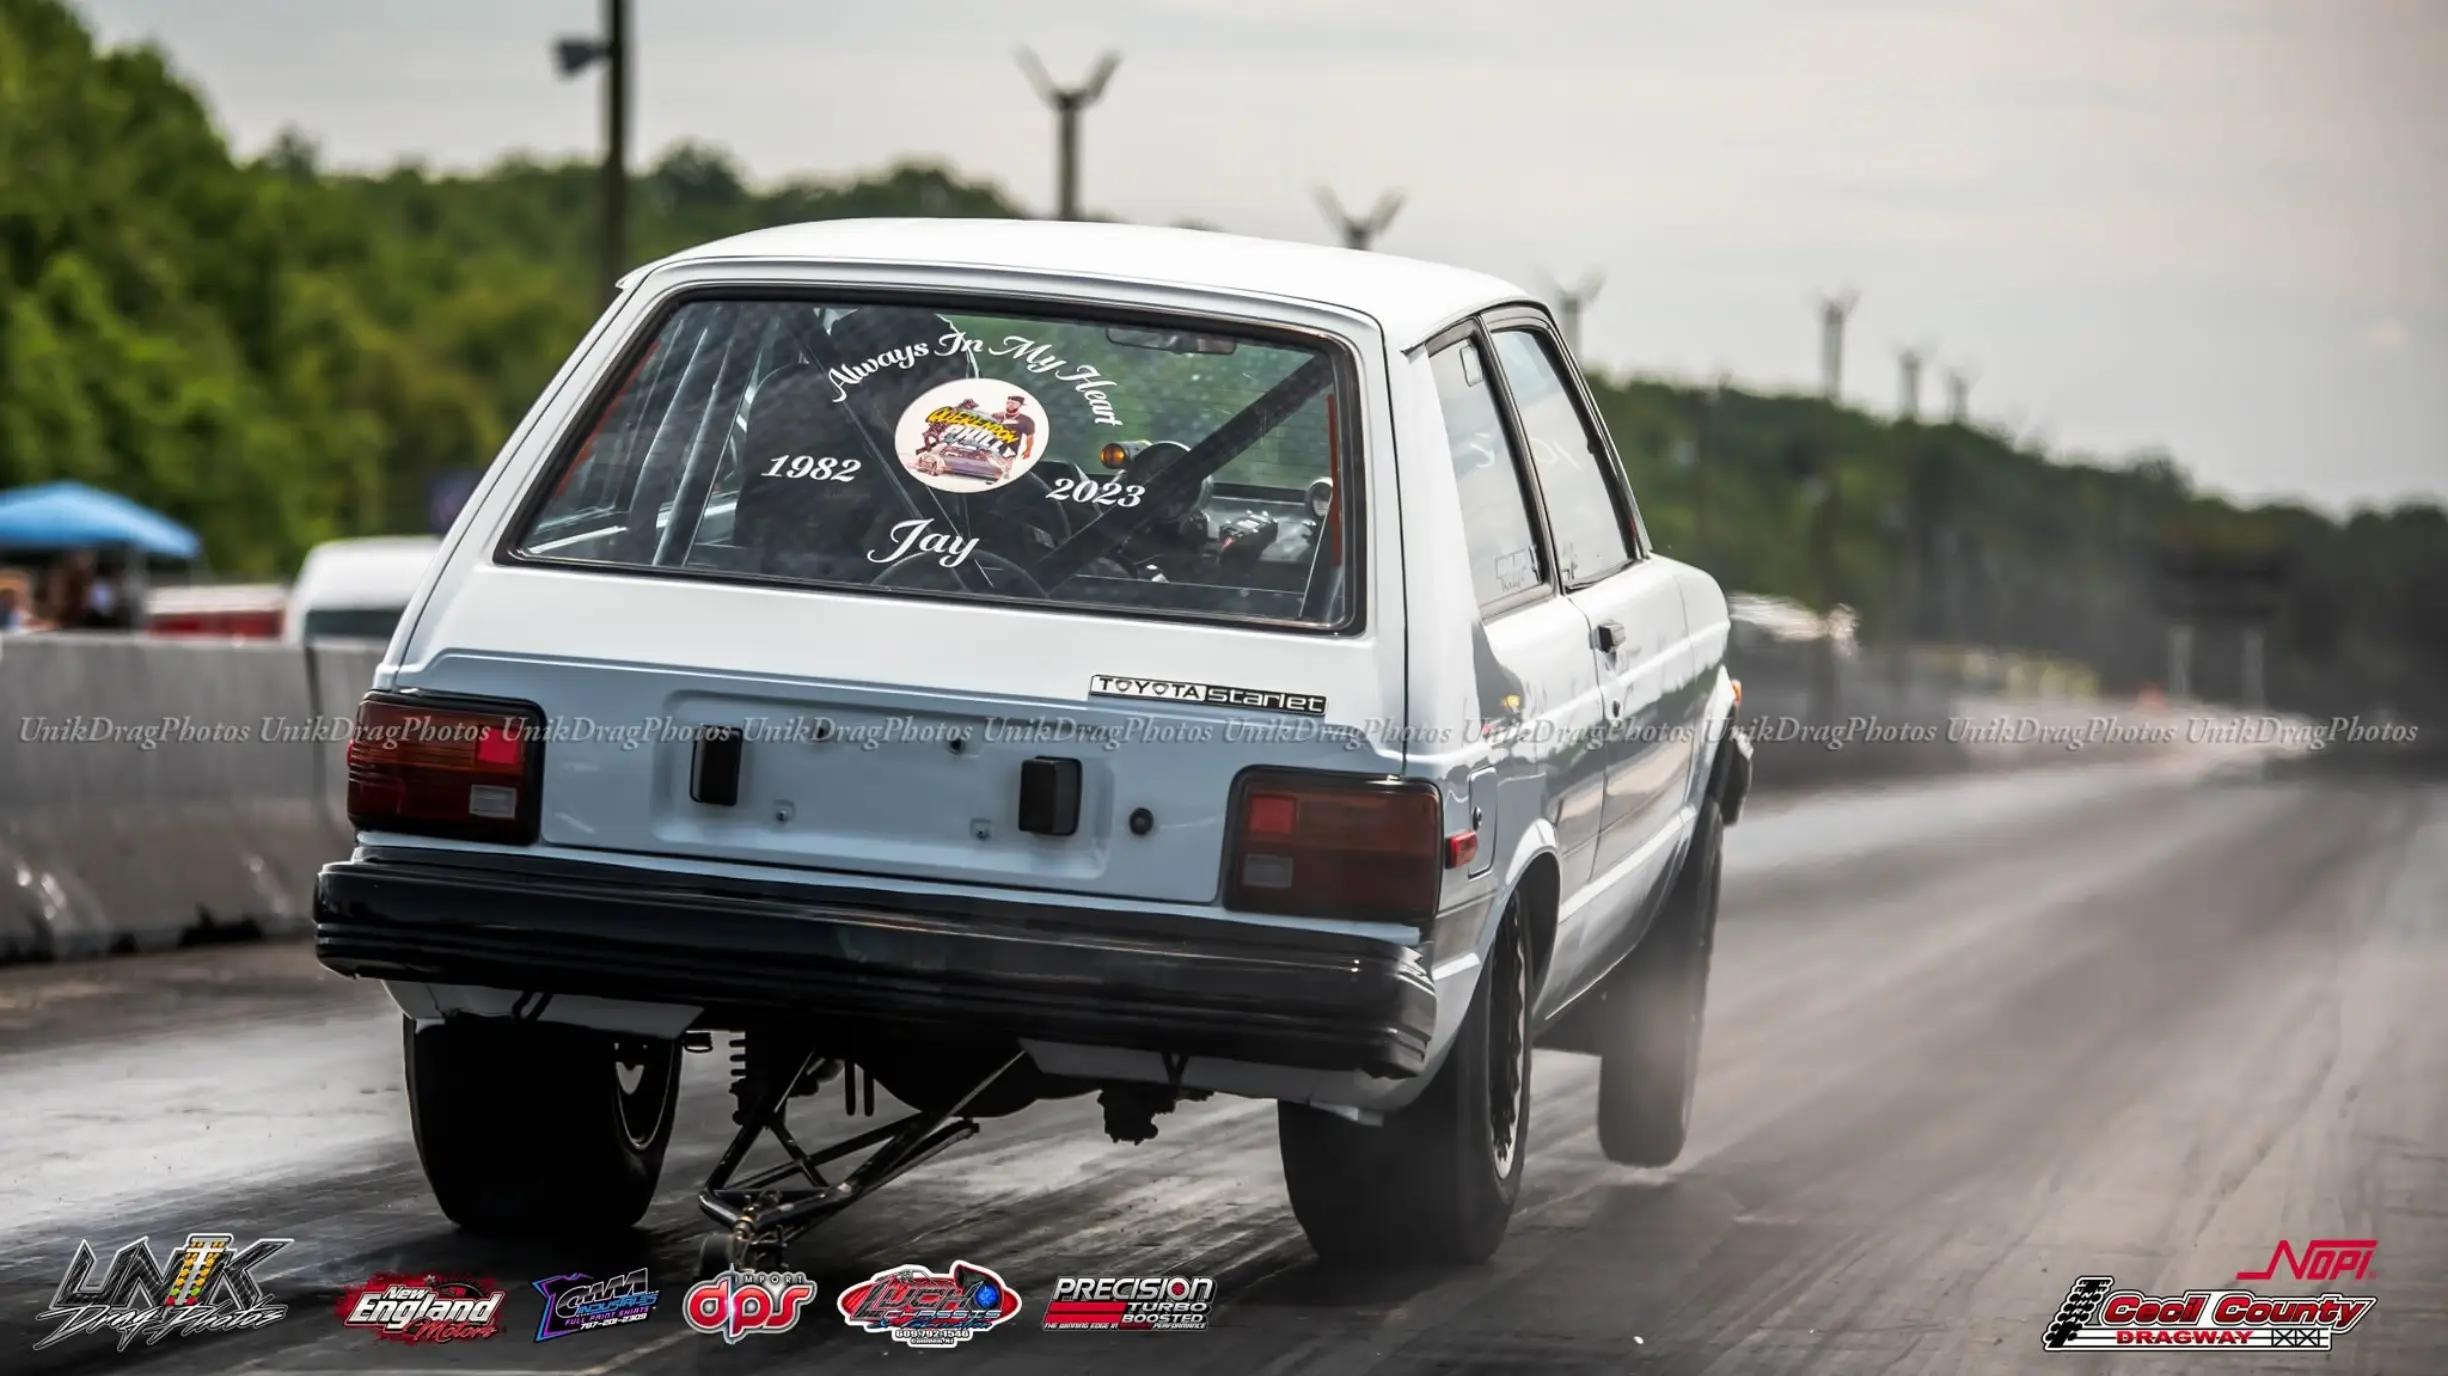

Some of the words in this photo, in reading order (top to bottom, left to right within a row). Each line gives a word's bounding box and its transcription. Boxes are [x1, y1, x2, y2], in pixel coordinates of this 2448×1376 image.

[825, 342, 930, 403] Always
[933, 331, 984, 358] In
[988, 335, 1067, 374] My
[1054, 364, 1123, 427] Heart
[760, 454, 863, 483] 1982
[1045, 477, 1146, 508] 2023
[866, 517, 980, 568] Jay
[1099, 677, 1202, 700] TOYOTA
